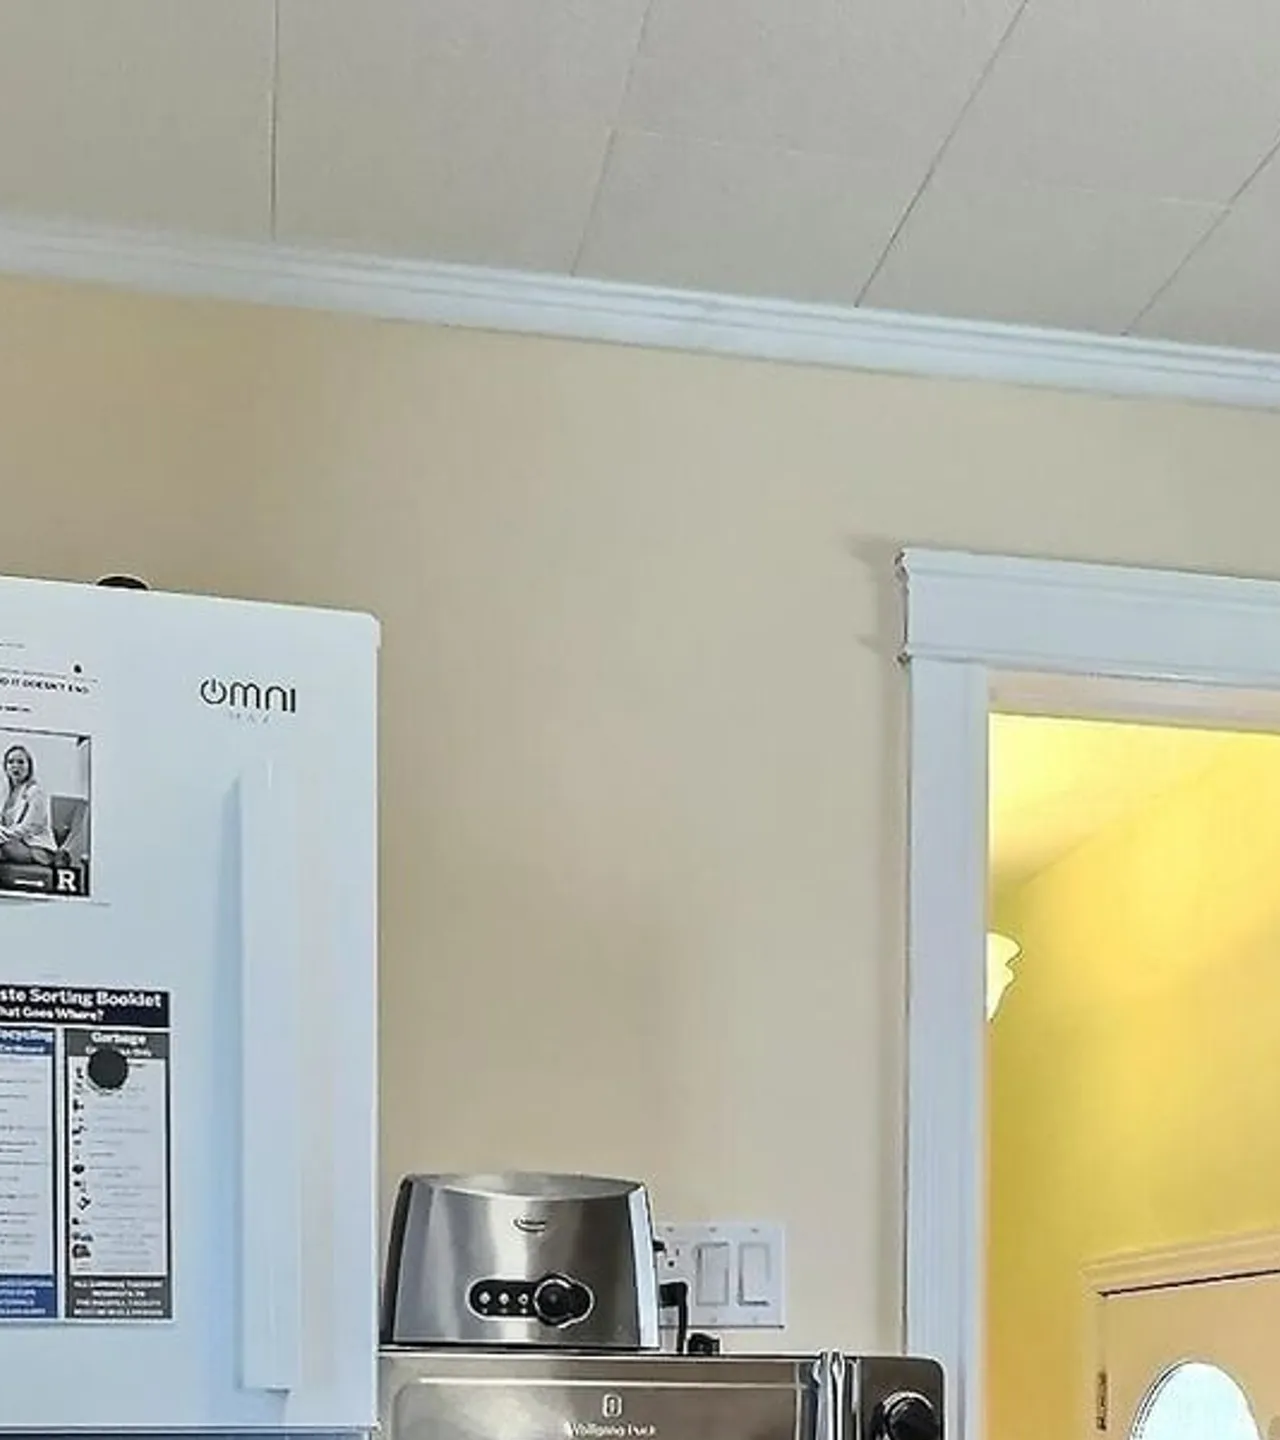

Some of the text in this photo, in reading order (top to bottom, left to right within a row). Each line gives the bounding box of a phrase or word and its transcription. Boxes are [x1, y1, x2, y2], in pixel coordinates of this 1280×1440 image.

[56, 868, 77, 891] R
[29, 988, 94, 1008] Sorting
[96, 991, 163, 1008] Booklet
[22, 1007, 53, 1019] Goes
[55, 1008, 105, 1021] Where?
[90, 1031, 147, 1046] Garbage
